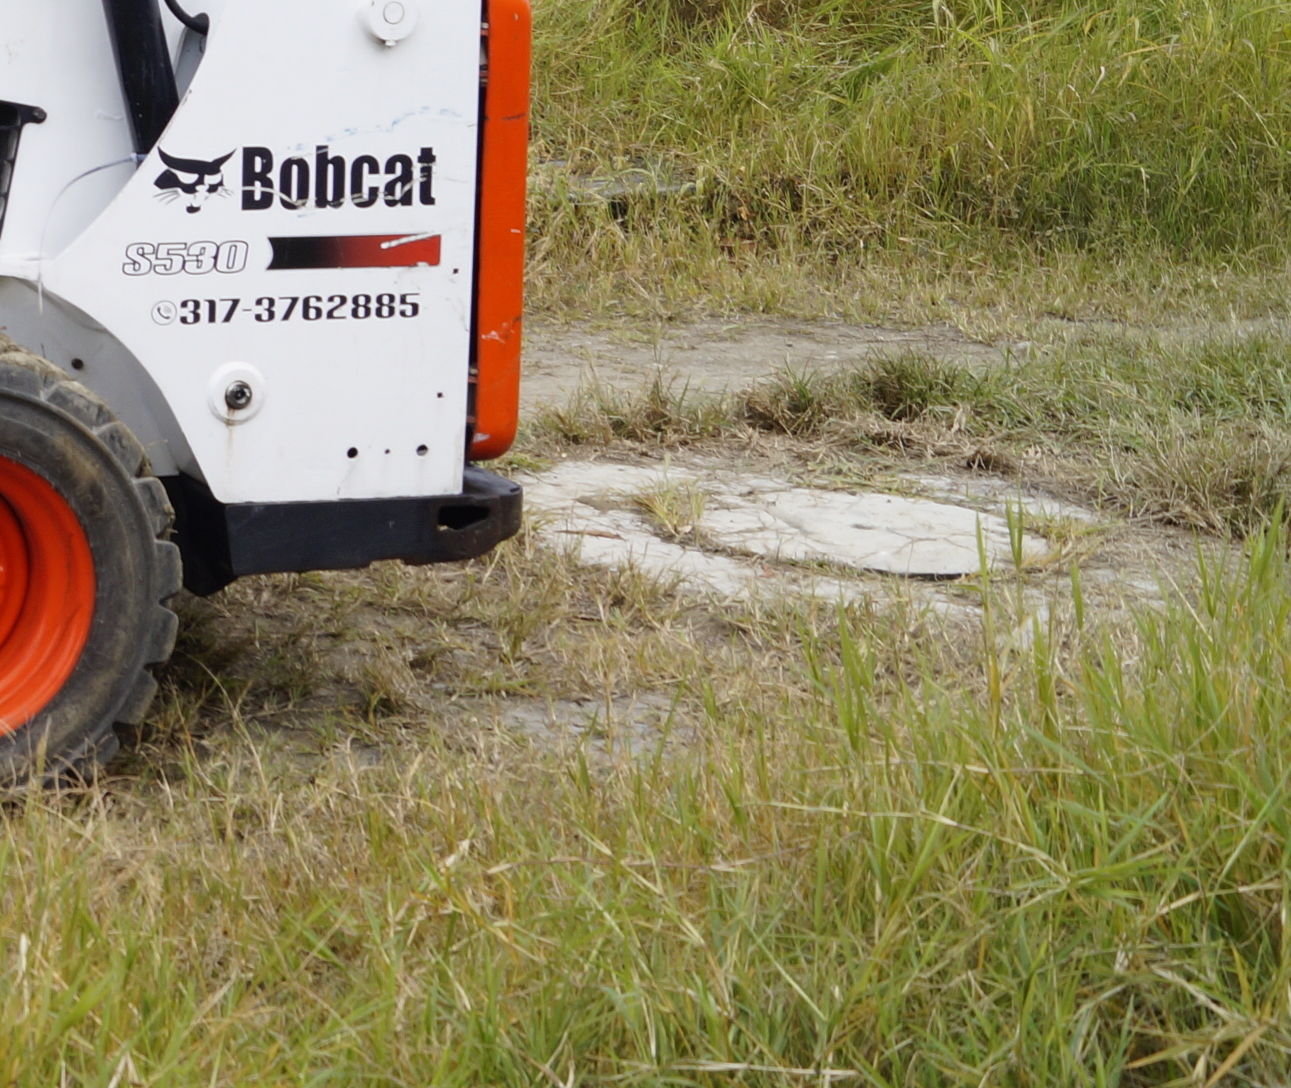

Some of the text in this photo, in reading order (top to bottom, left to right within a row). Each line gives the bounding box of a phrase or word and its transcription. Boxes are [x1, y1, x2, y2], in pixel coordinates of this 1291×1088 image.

[241, 145, 436, 211] Bobcat
[122, 240, 249, 276] S530
[179, 293, 421, 325] 317-3762885
